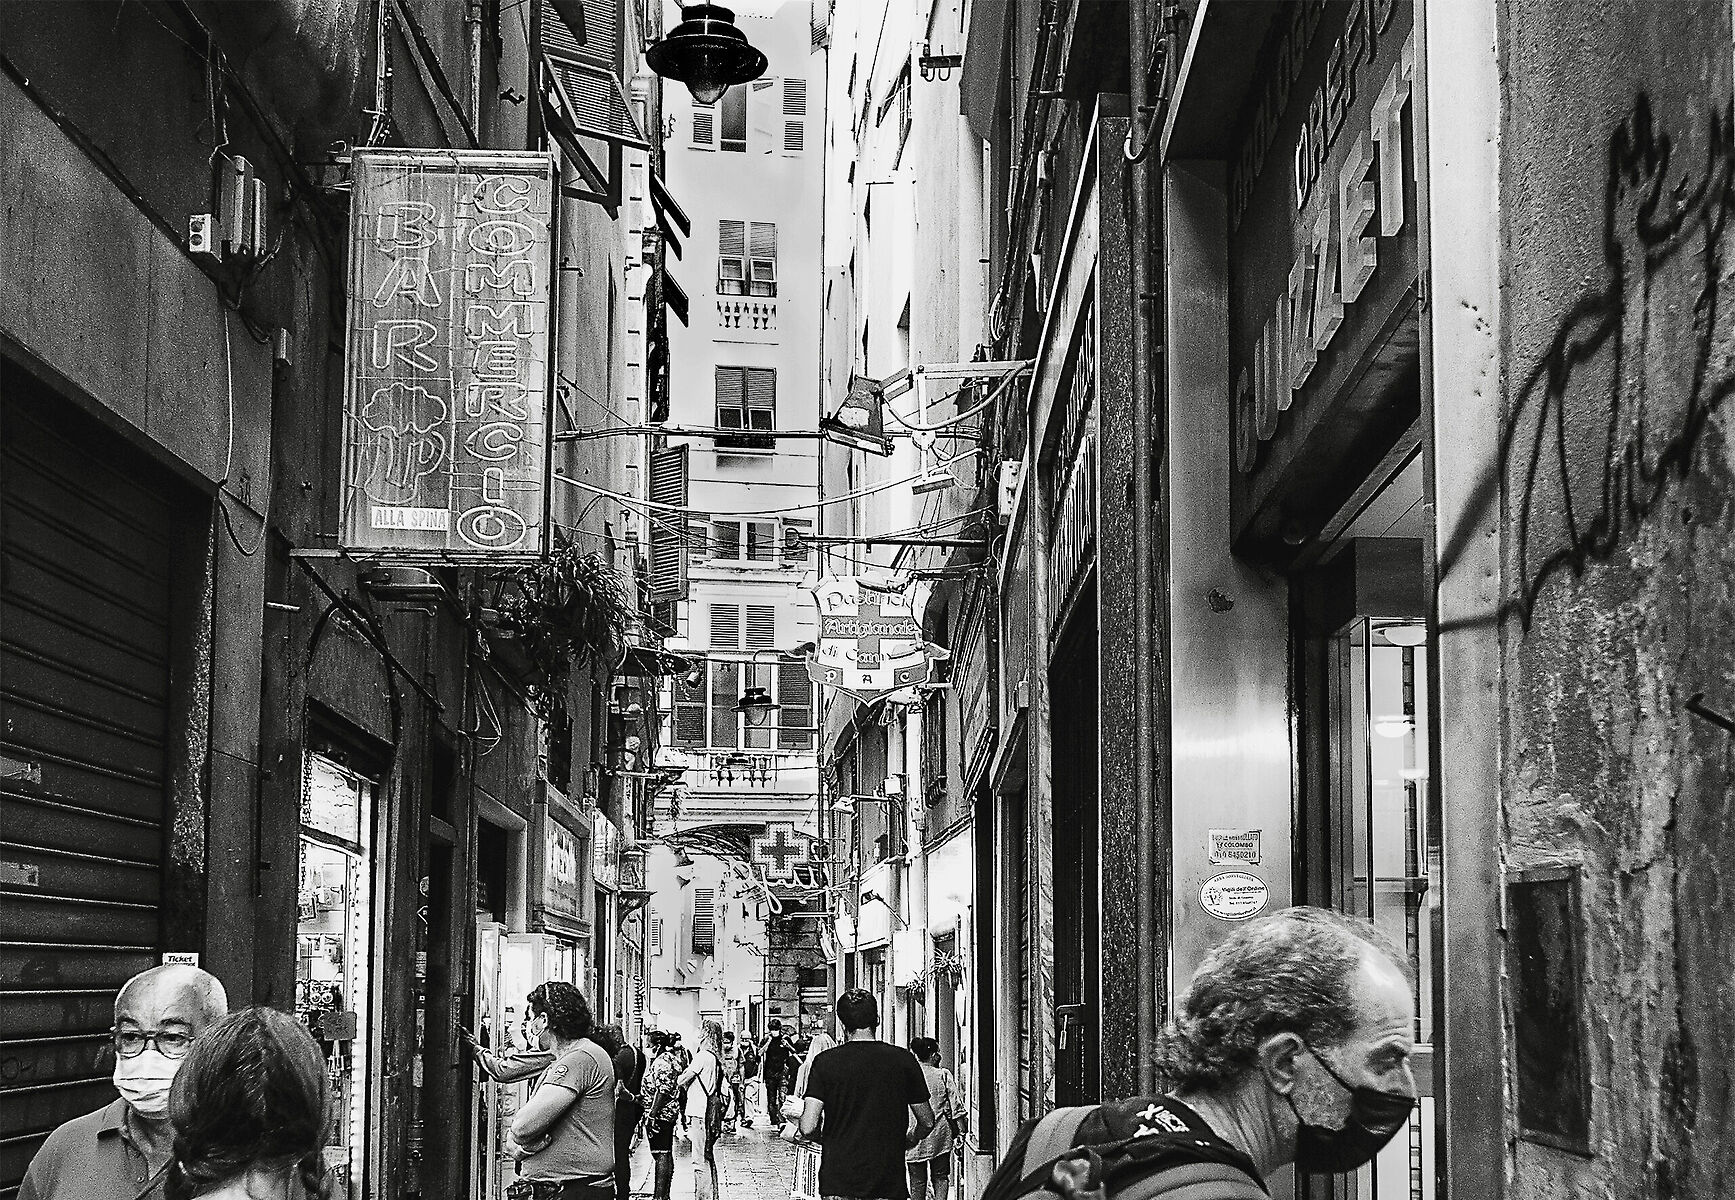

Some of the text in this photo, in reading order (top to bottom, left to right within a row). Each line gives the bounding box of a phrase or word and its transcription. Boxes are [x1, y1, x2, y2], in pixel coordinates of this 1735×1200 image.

[372, 200, 442, 372] BAR
[457, 174, 535, 551] COMMERCIO
[374, 509, 446, 529] ALLA SPINA
[823, 618, 916, 639] Artigianale
[167, 955, 193, 963] Ticket
